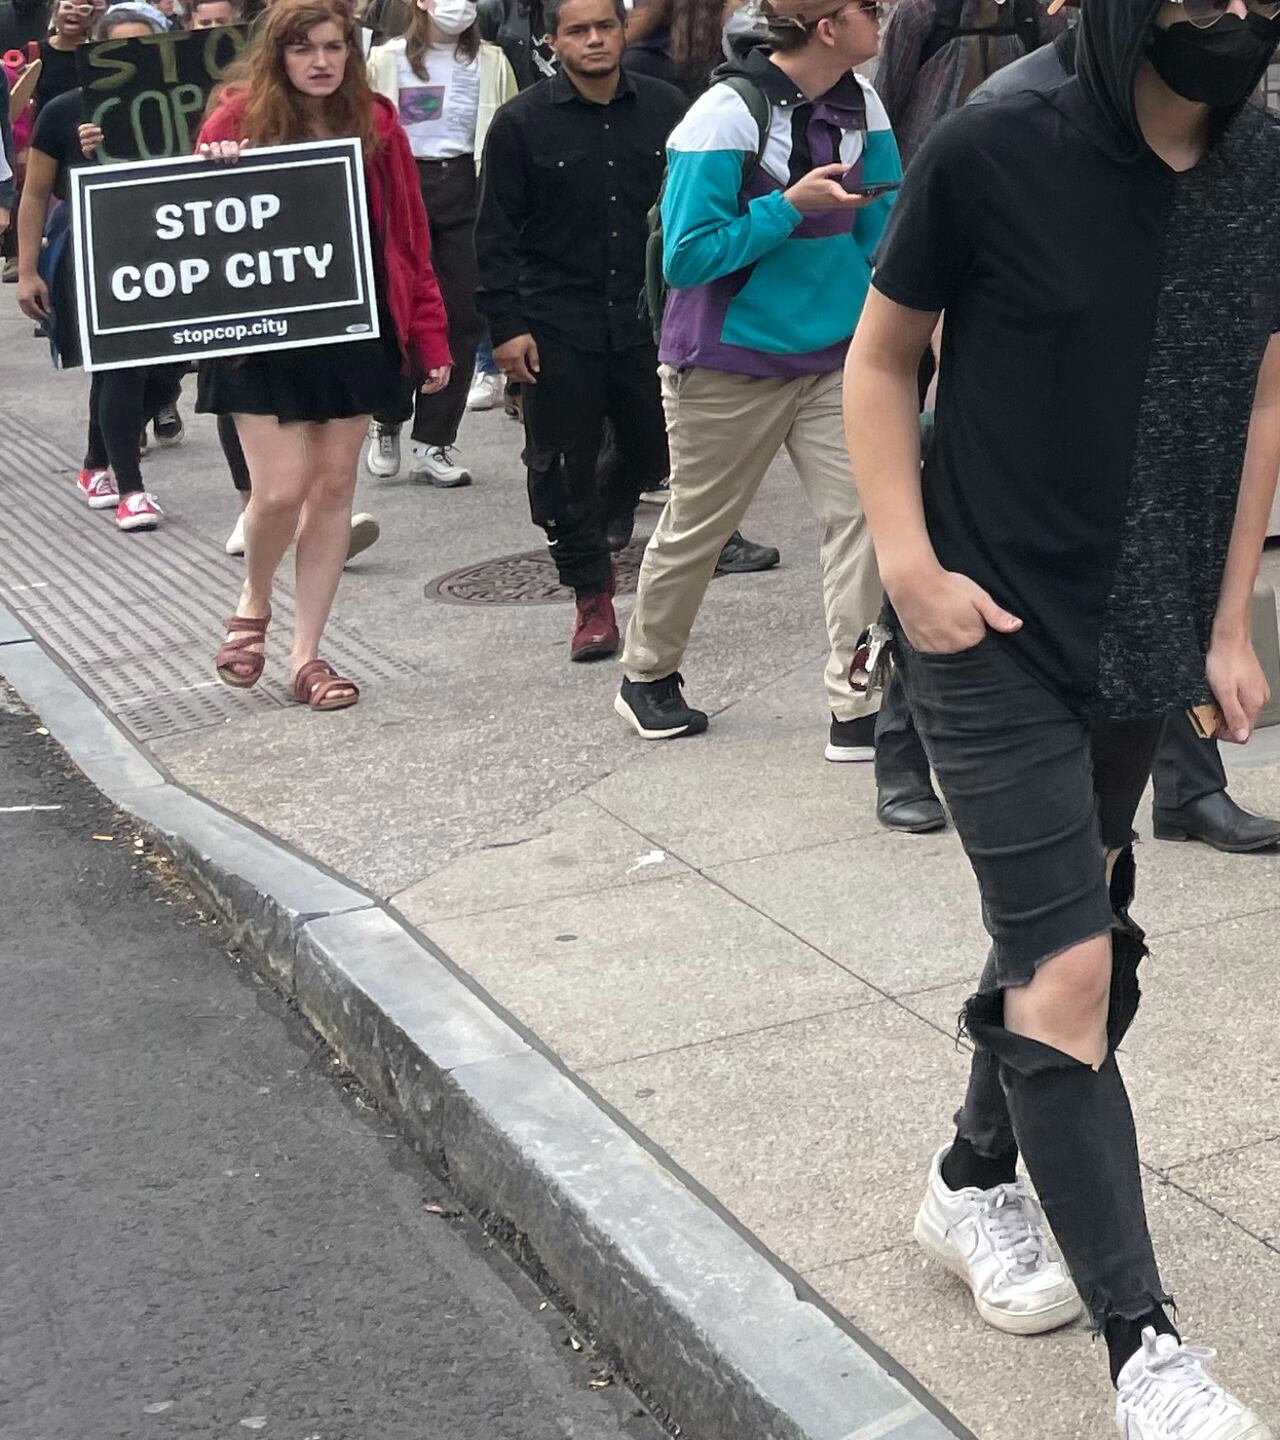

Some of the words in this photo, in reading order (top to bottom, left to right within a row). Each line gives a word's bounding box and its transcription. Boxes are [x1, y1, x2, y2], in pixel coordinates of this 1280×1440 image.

[88, 26, 248, 90] STO
[92, 83, 203, 165] COP
[155, 193, 280, 240] STOP
[111, 258, 210, 302] COP
[225, 242, 334, 288] CITY
[173, 318, 288, 345] stopcop.city
